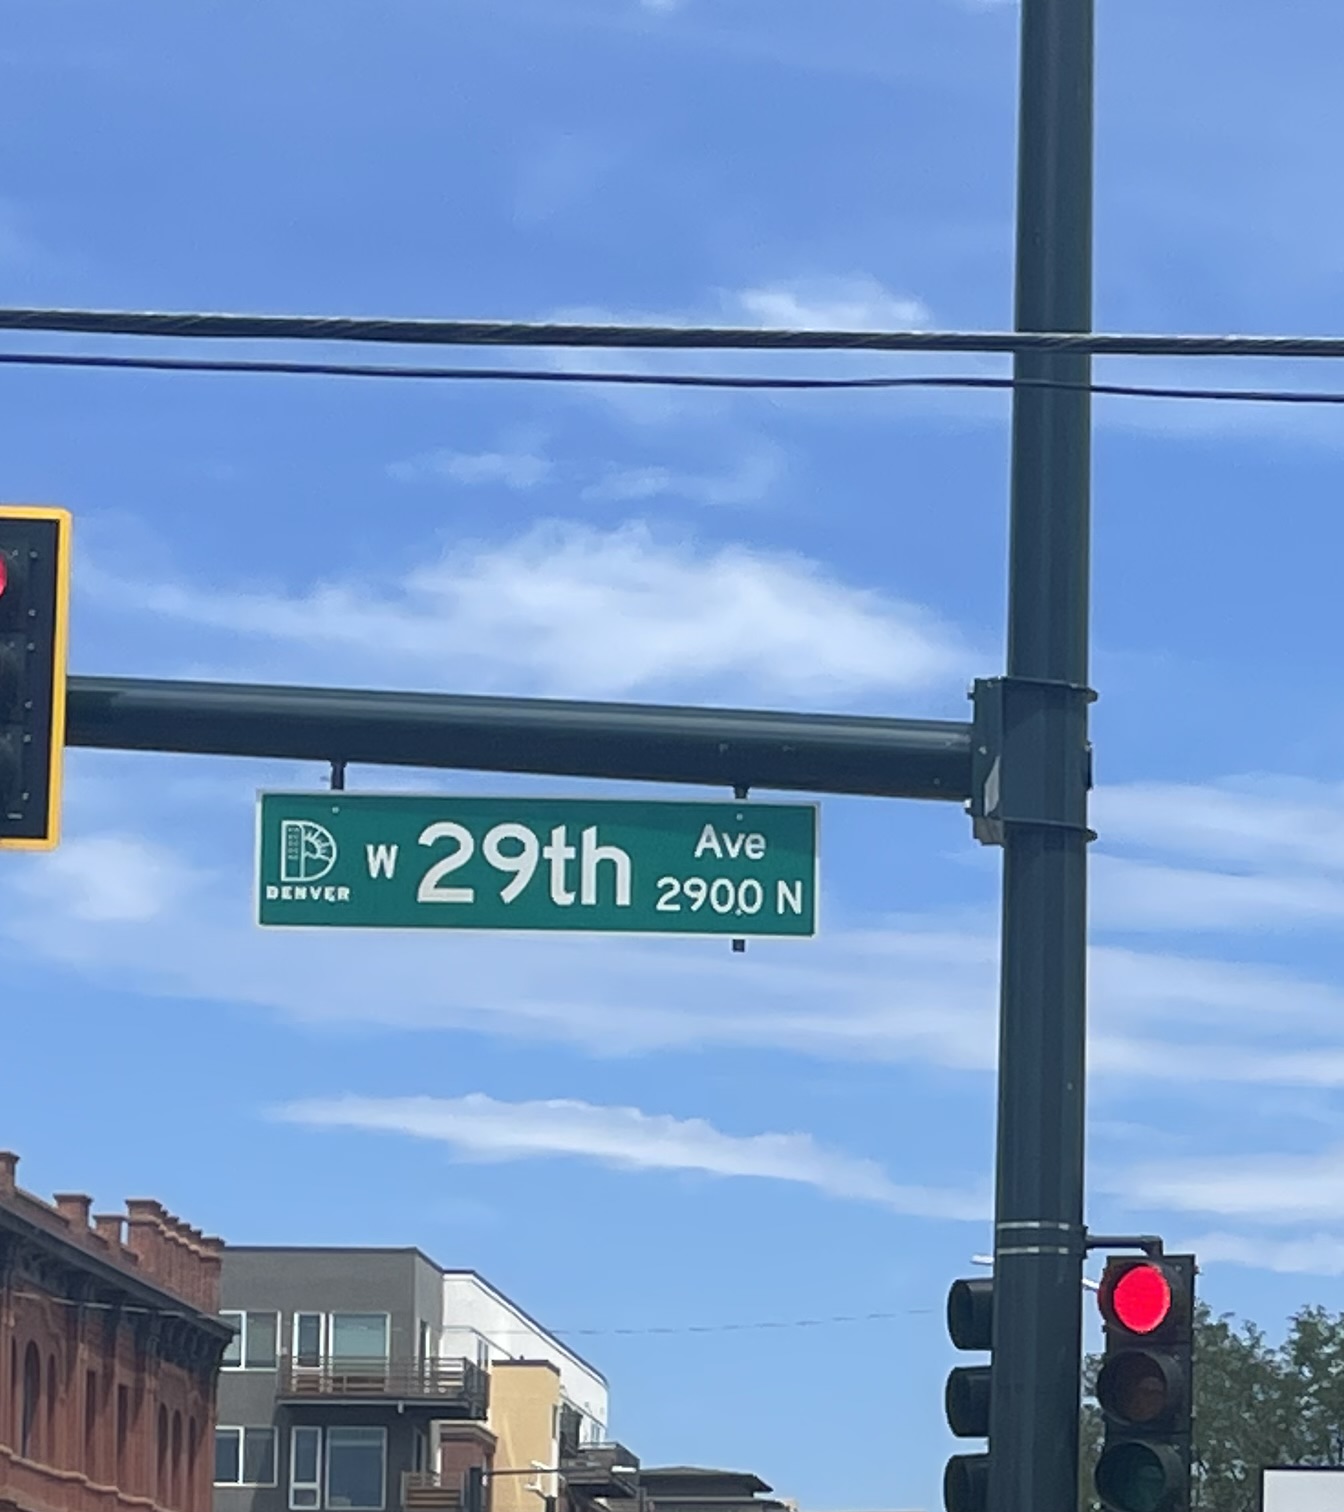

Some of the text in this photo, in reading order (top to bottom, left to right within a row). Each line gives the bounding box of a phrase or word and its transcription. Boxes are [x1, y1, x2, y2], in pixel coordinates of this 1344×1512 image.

[366, 821, 767, 906] W 29th Ave
[266, 886, 350, 901] DENVER
[656, 876, 803, 914] 2900 N
